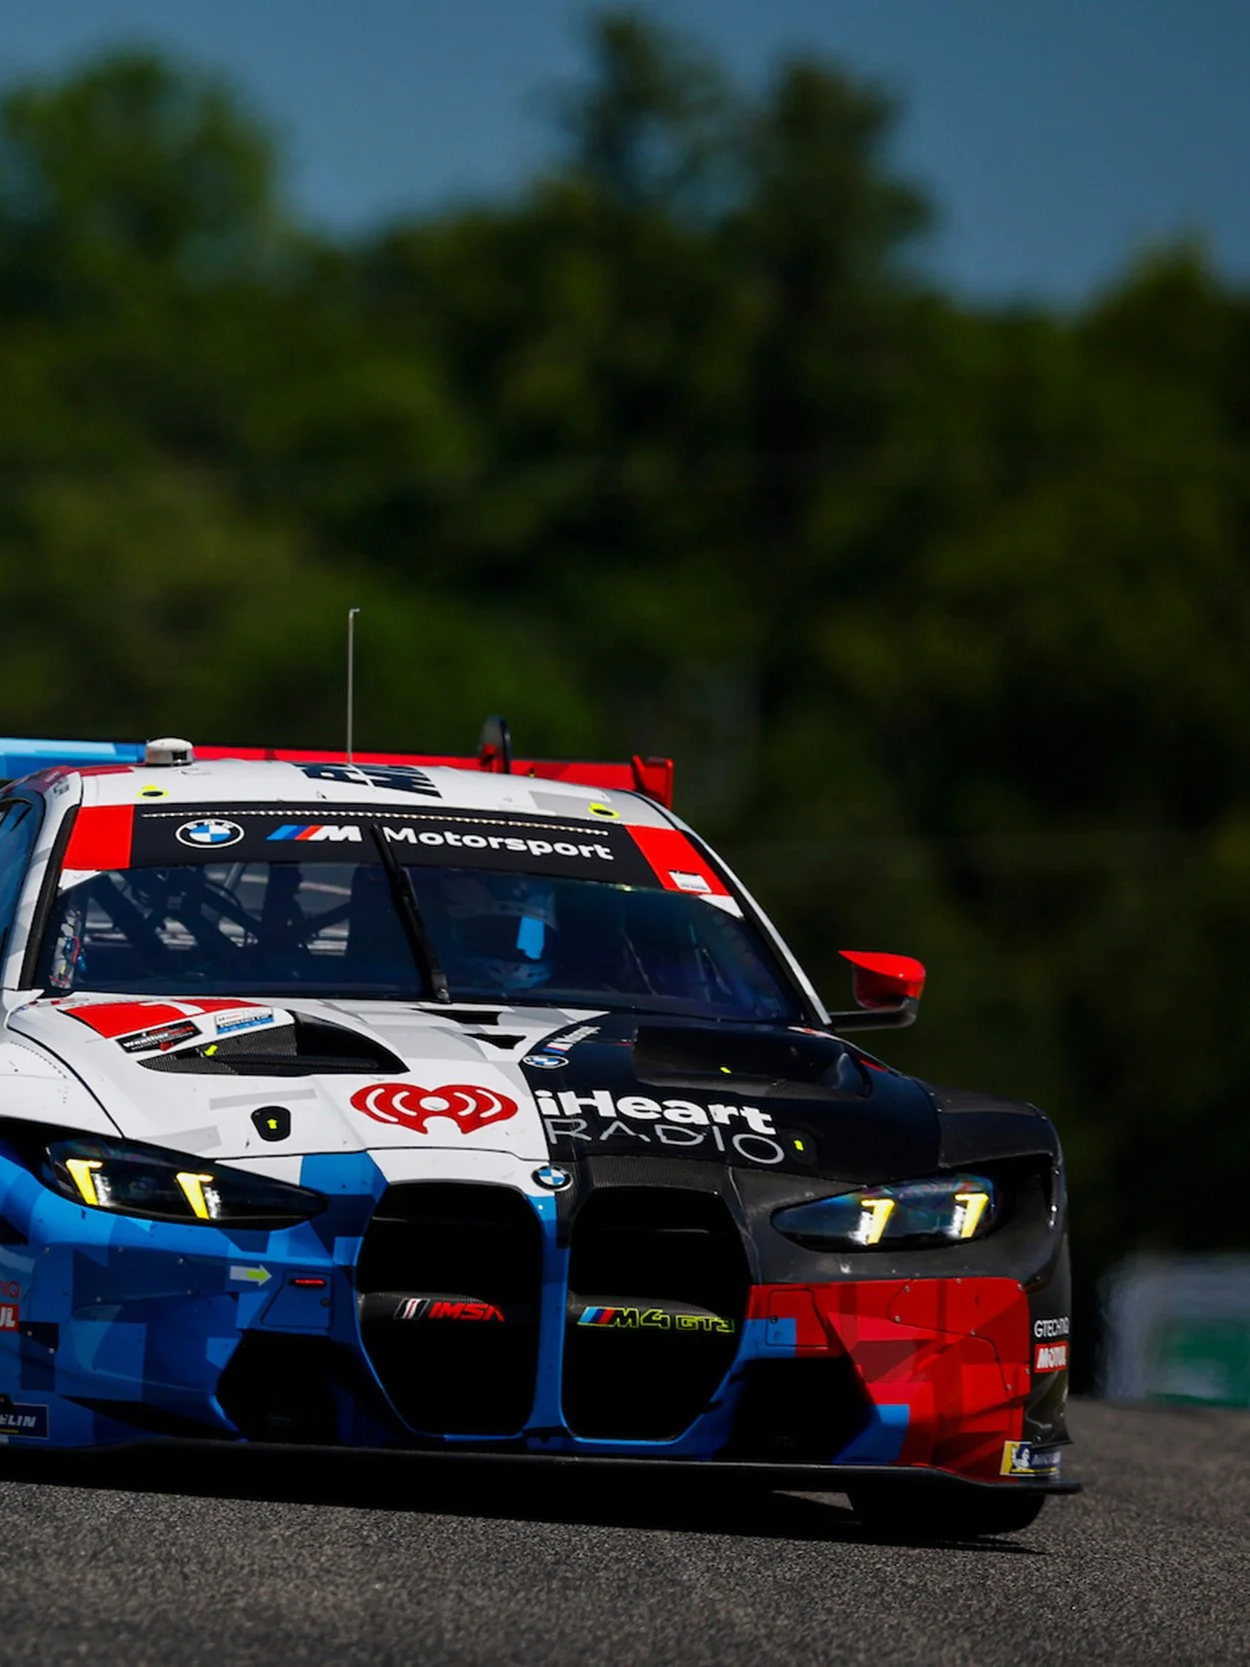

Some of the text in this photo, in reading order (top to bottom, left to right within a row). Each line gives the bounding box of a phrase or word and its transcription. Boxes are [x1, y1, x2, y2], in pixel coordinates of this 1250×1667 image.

[382, 826, 614, 860] Motorsport
[534, 1089, 777, 1135] iHeart
[543, 1117, 786, 1165] RADIO
[429, 1301, 506, 1322] IMSA
